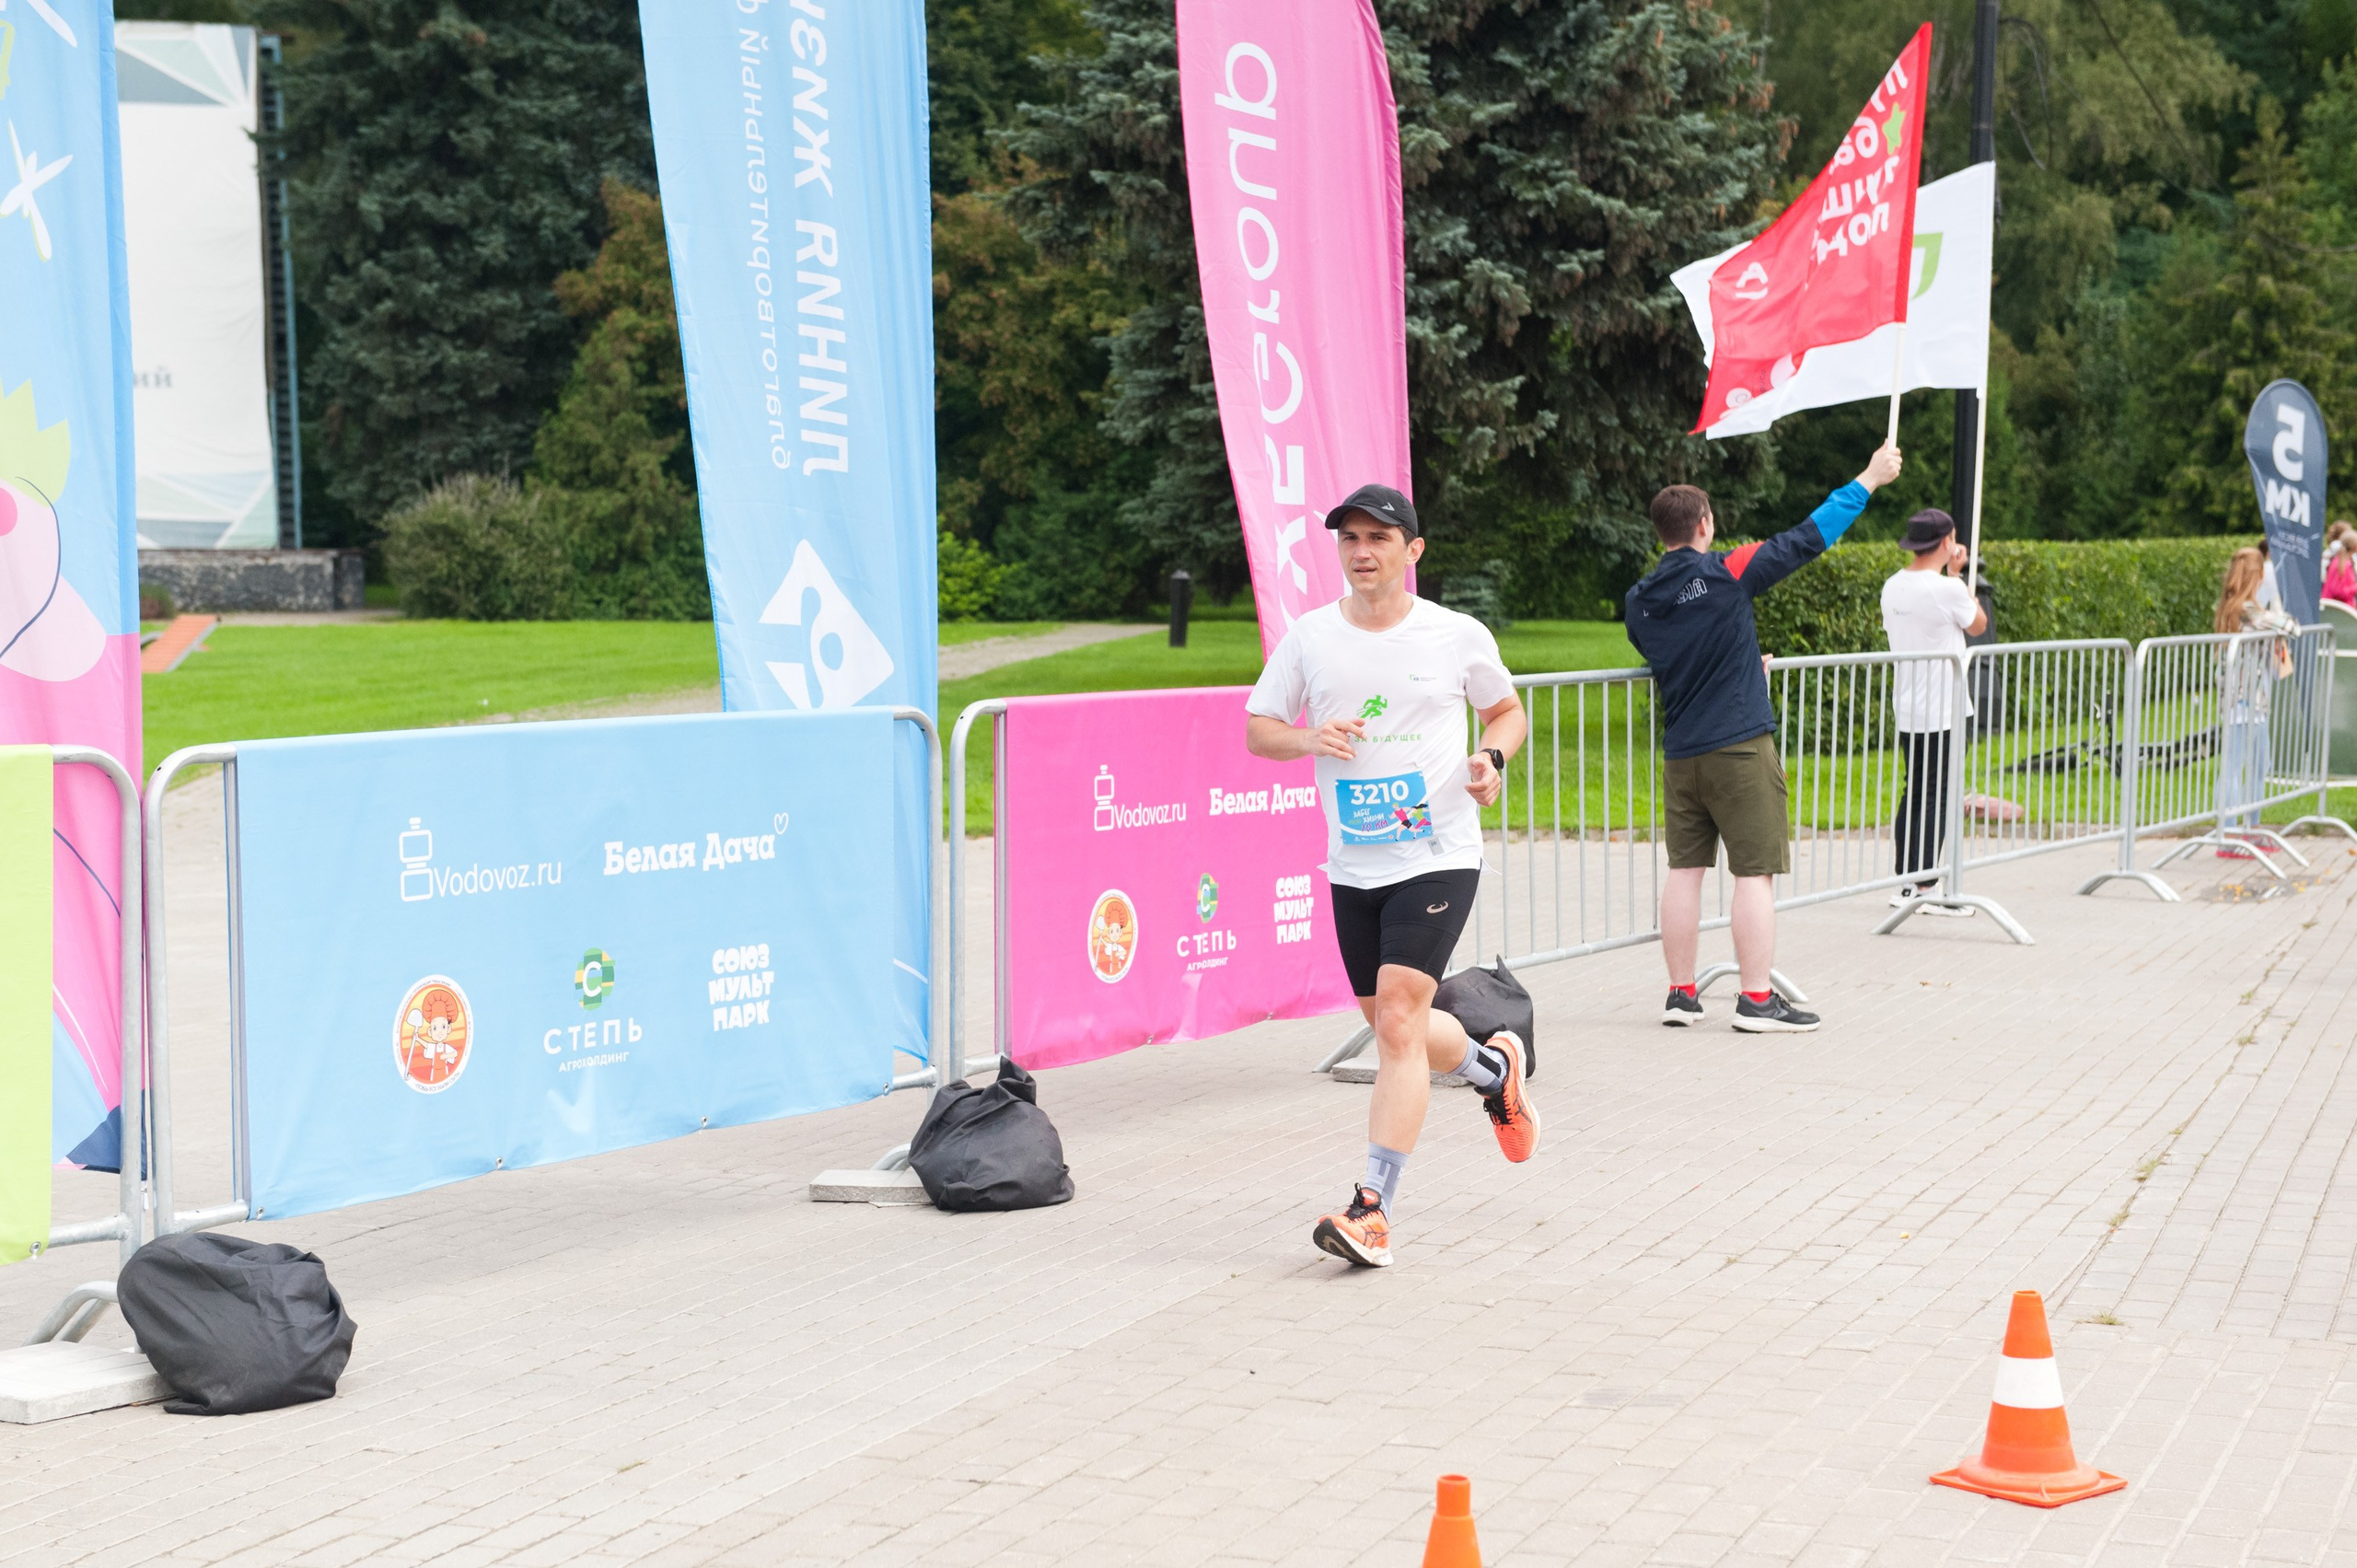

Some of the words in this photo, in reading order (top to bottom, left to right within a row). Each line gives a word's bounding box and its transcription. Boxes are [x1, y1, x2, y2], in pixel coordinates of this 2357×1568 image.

[1373, 734, 1422, 743] БУДУЩЕЕ
[1209, 787, 1268, 816] Белая
[1271, 784, 1316, 815] Дача
[1350, 780, 1409, 806] 3210
[1115, 802, 1187, 830] Vodovoz.ru
[603, 841, 697, 876] Белая
[703, 832, 775, 872] Дача
[434, 861, 562, 898] Vodovoz.ru
[1275, 874, 1312, 899] СОЮЗ
[1273, 897, 1315, 923] МУЛЬТ
[1176, 929, 1237, 958] СТЕПЬ
[1276, 921, 1312, 945] ПАРК
[712, 943, 770, 974] СОЮЗ
[708, 970, 775, 1005] МУЛЬТ
[713, 999, 771, 1031] ПАРК
[543, 1017, 643, 1055] СТЕПЬ
[559, 1051, 630, 1073] АГРОХОЛДИНГ
